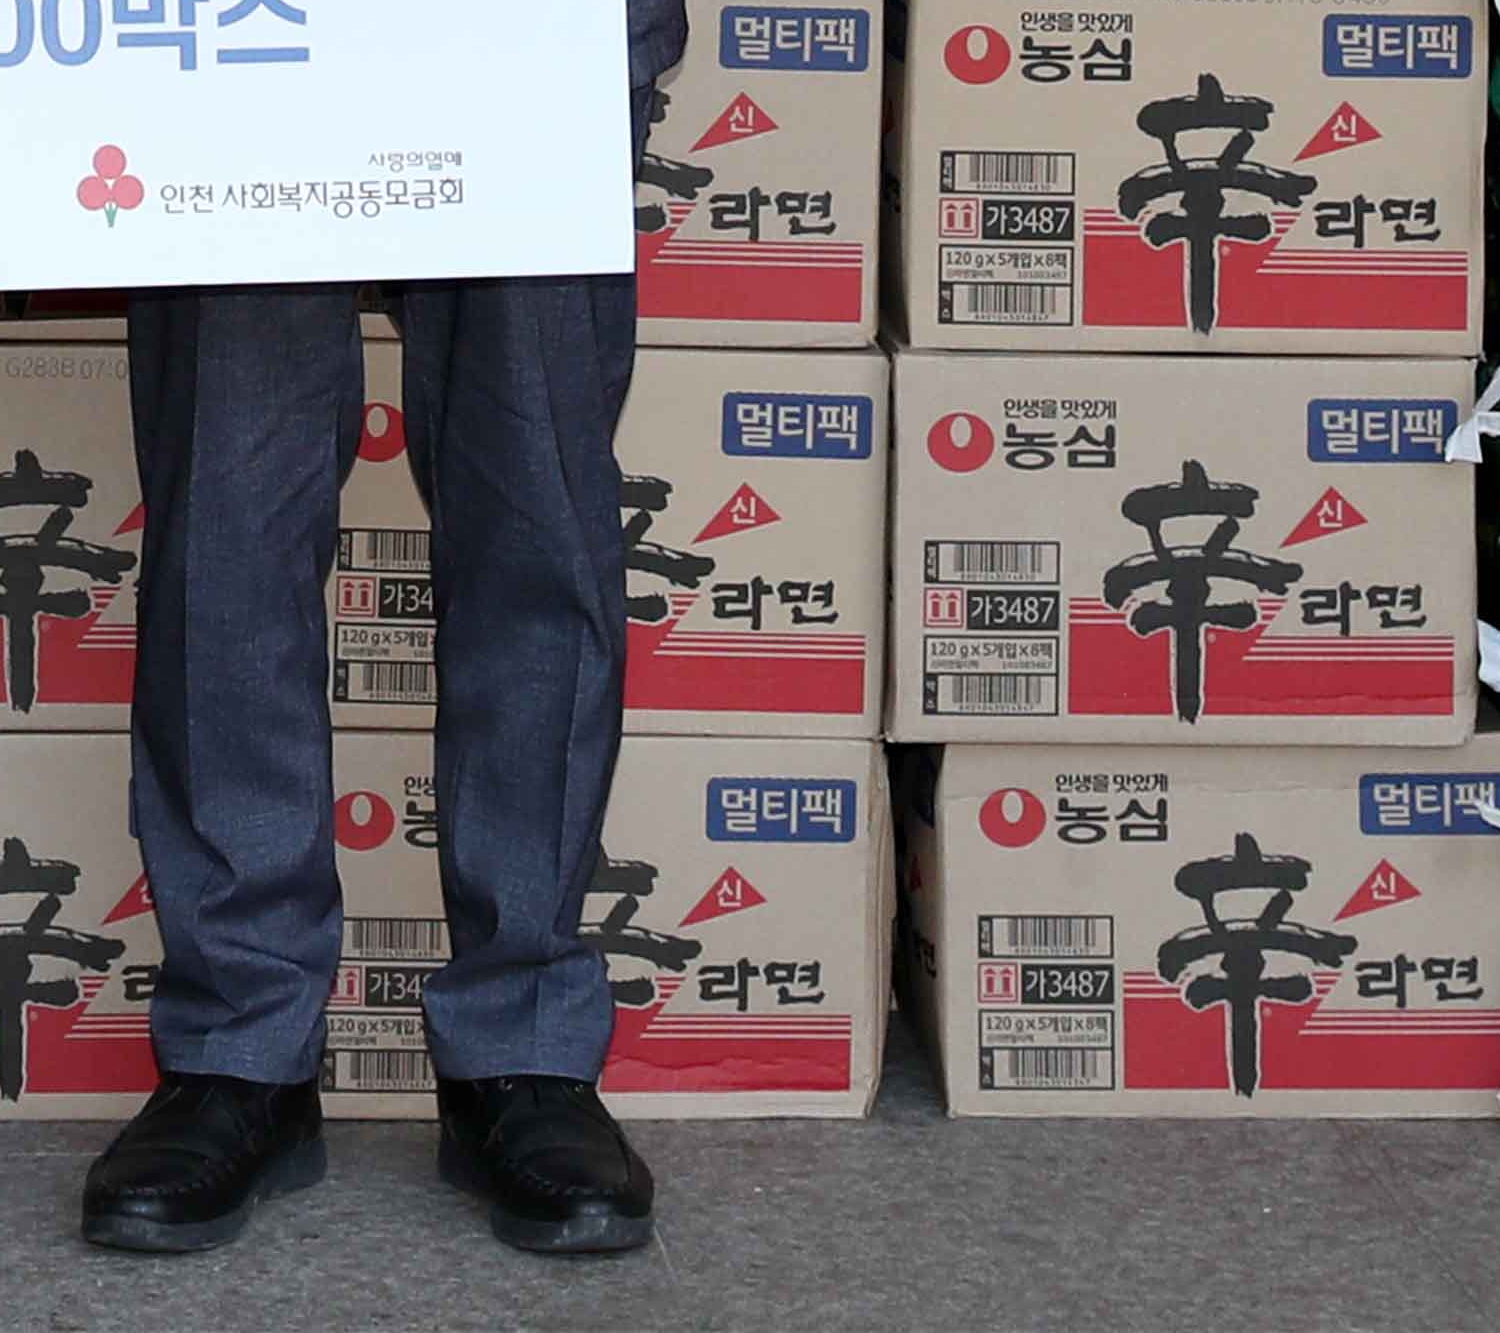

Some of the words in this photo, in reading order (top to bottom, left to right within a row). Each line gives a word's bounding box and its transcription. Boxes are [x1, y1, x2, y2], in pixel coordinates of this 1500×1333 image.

[734, 16, 856, 63] 멀티팩
[1019, 37, 1132, 82] 농심
[1336, 23, 1458, 68] 멀티팩
[368, 151, 463, 172] 사랑의열매
[160, 183, 214, 214] 인천
[223, 178, 463, 219] 사회복지공동모금회
[710, 187, 836, 241] 라면
[986, 205, 1069, 235] 가3487
[1117, 73, 1317, 335] 辛
[1313, 194, 1440, 247] 라면
[736, 403, 858, 451] 멀티팩
[1003, 424, 1116, 470] 농심
[1320, 408, 1444, 454] 멀티팩
[711, 576, 838, 630] 라면
[971, 596, 1055, 625] 가3487
[1300, 581, 1426, 636] 라면
[721, 788, 843, 833] 멀티팩
[1055, 797, 1167, 844] 농심
[697, 958, 824, 1011] 라면
[1026, 970, 1109, 999] 가3487
[1157, 832, 1357, 1098] 辛
[1355, 954, 1483, 1007] 라면
